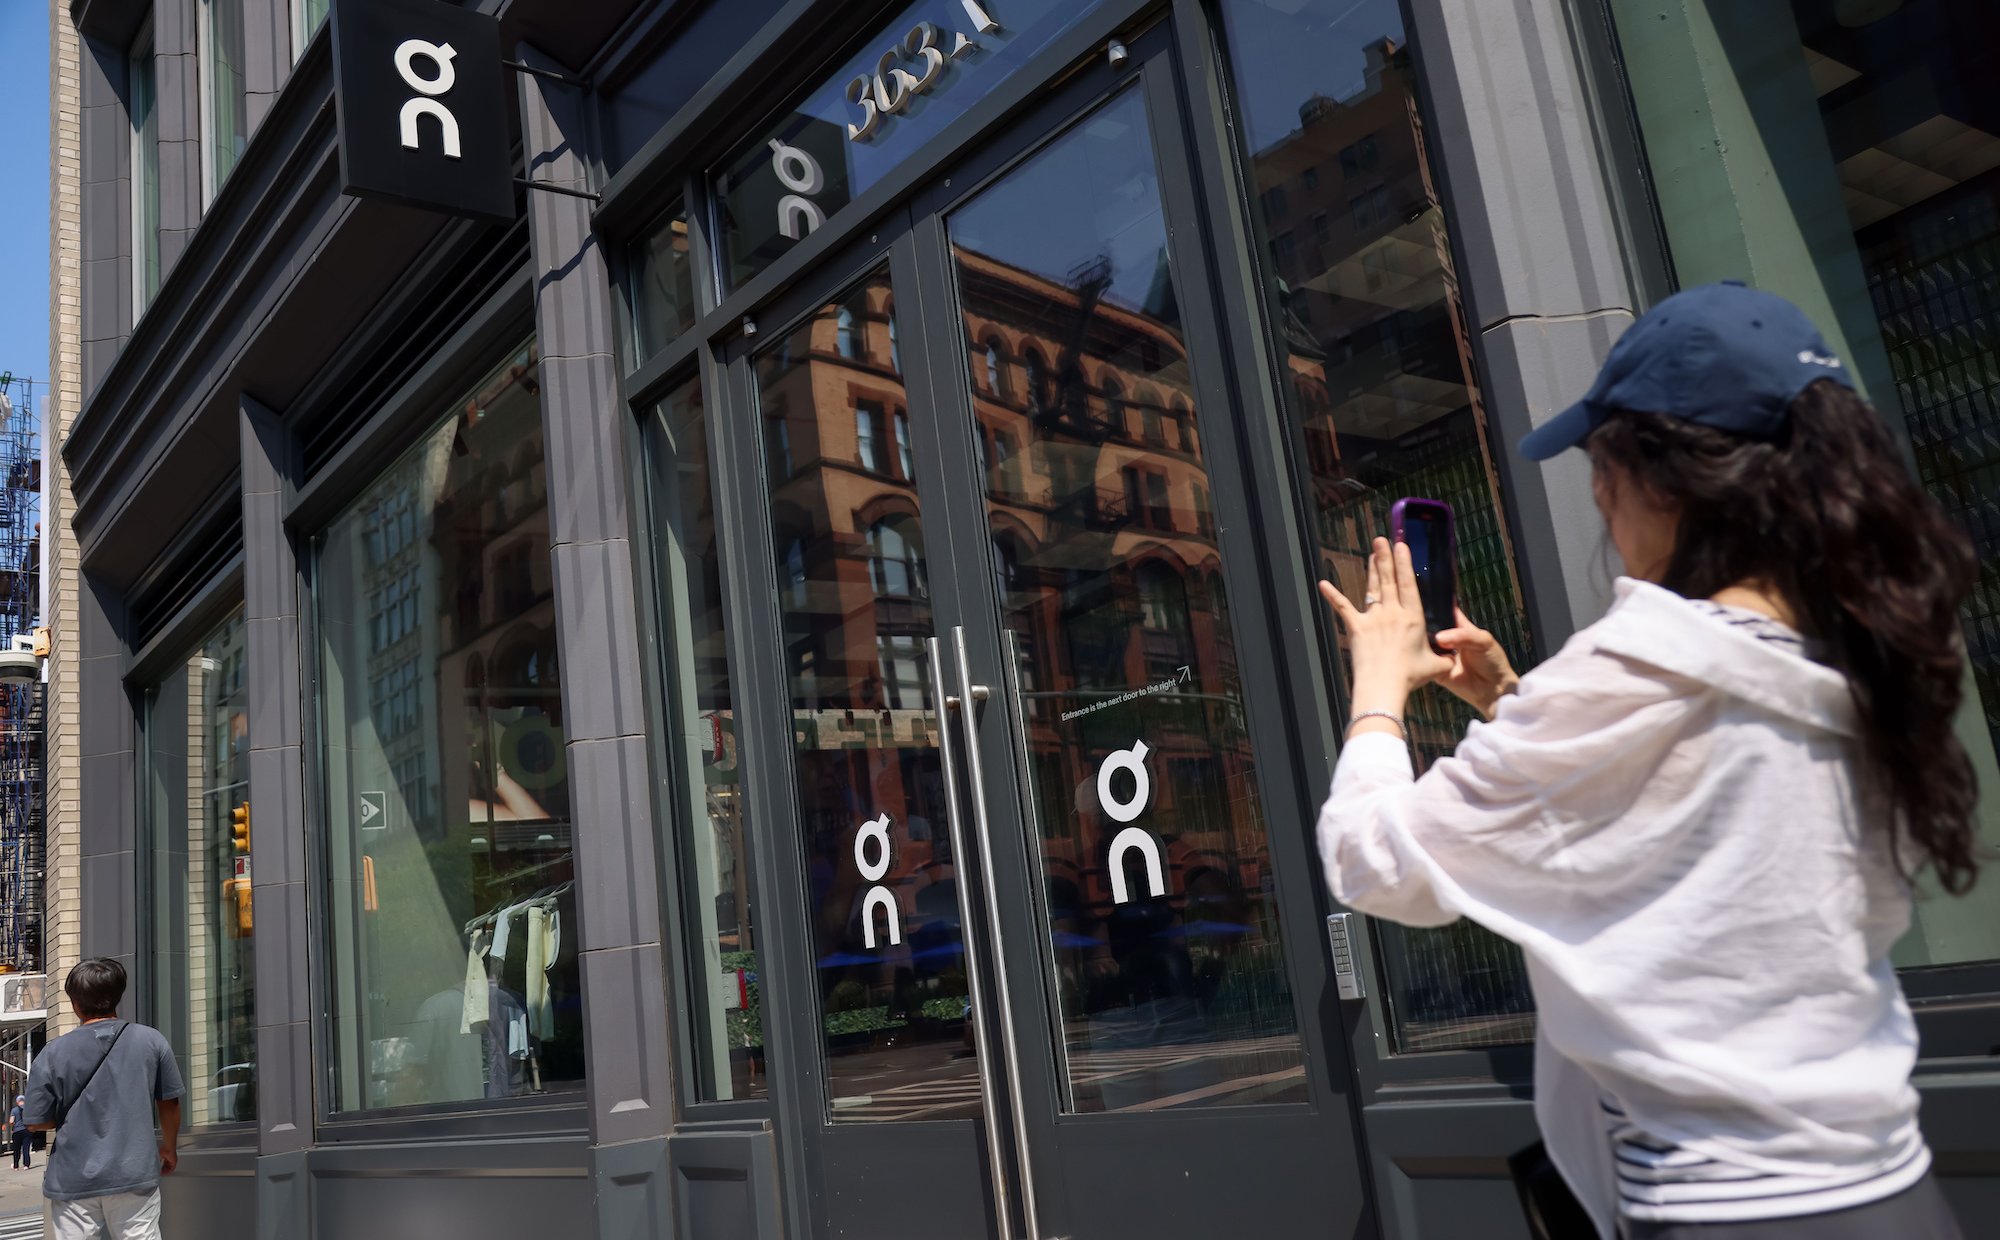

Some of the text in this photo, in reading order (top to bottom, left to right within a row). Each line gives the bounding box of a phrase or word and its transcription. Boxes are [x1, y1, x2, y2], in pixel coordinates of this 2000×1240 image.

[1061, 678, 1176, 721] Entrance is the next door to the right
